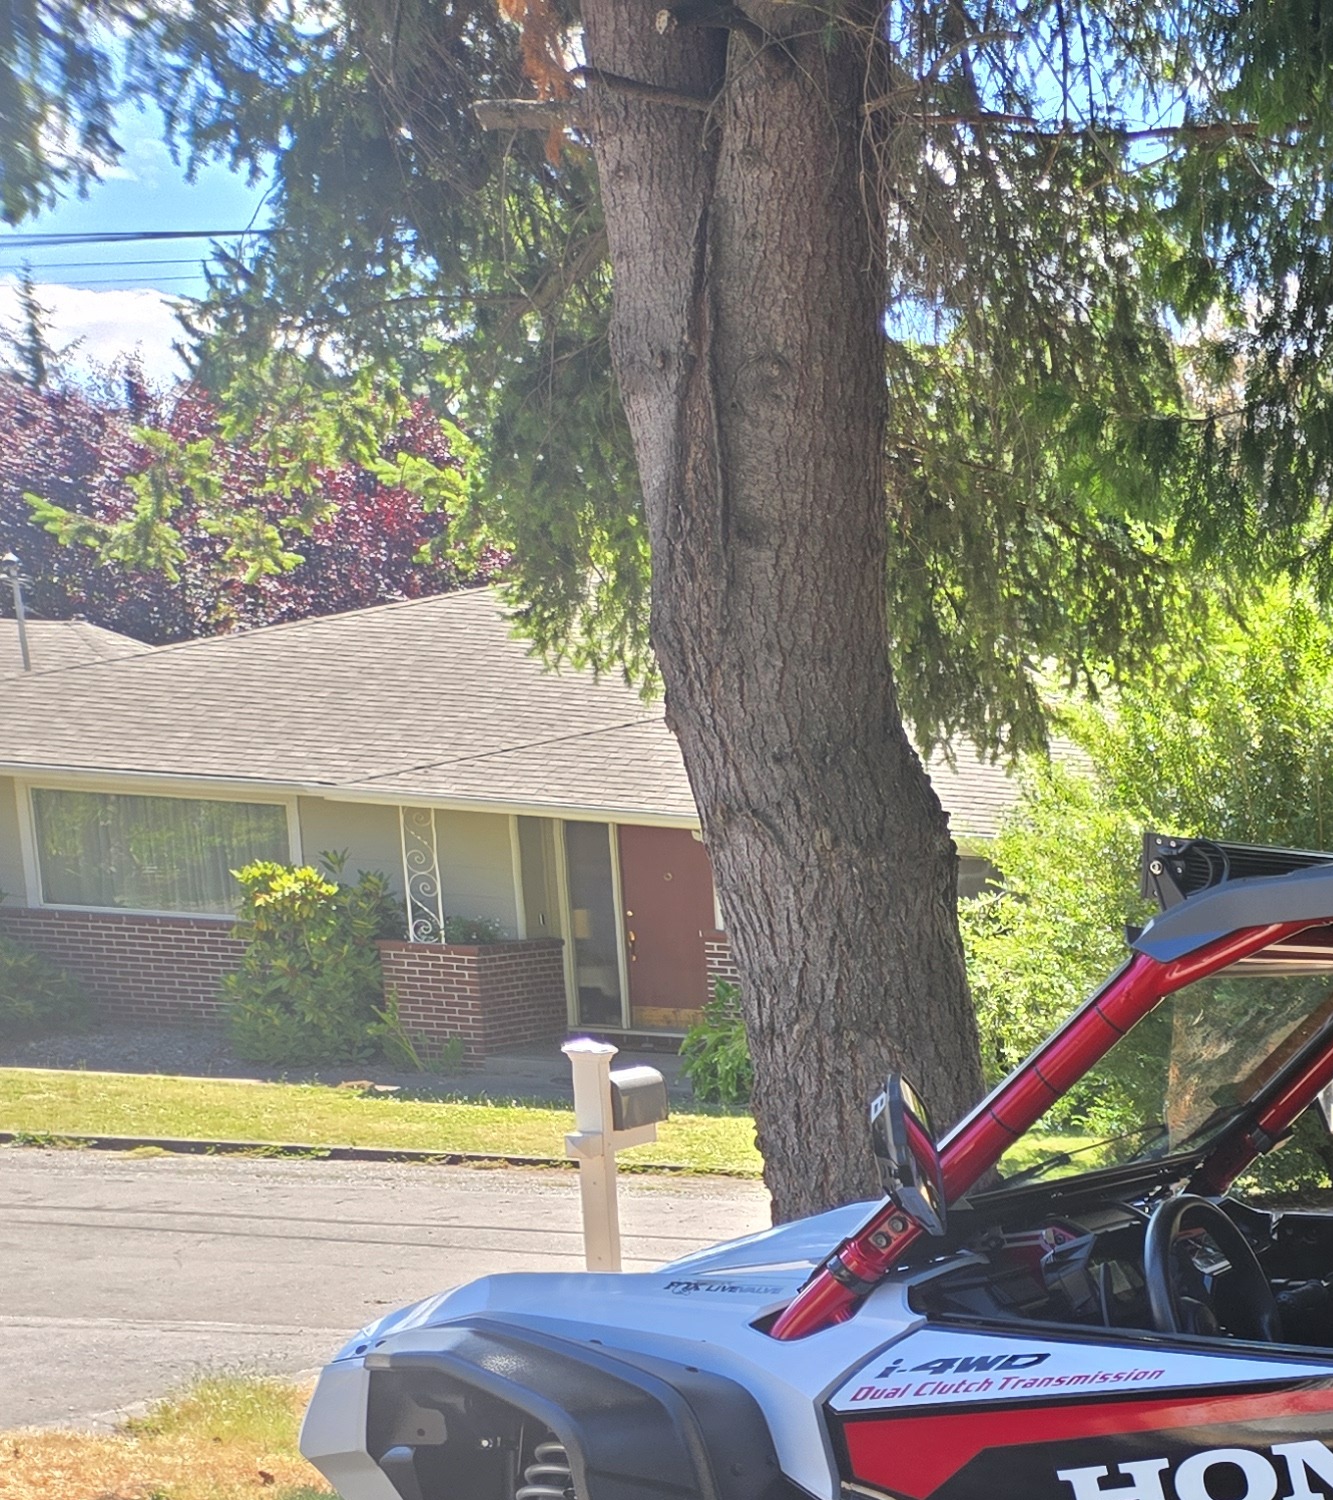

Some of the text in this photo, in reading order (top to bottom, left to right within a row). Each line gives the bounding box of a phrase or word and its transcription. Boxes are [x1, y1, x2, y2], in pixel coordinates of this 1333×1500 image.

[874, 1352, 1052, 1380] i-4WD
[849, 1368, 1166, 1402] Dual Clutch Transmission
